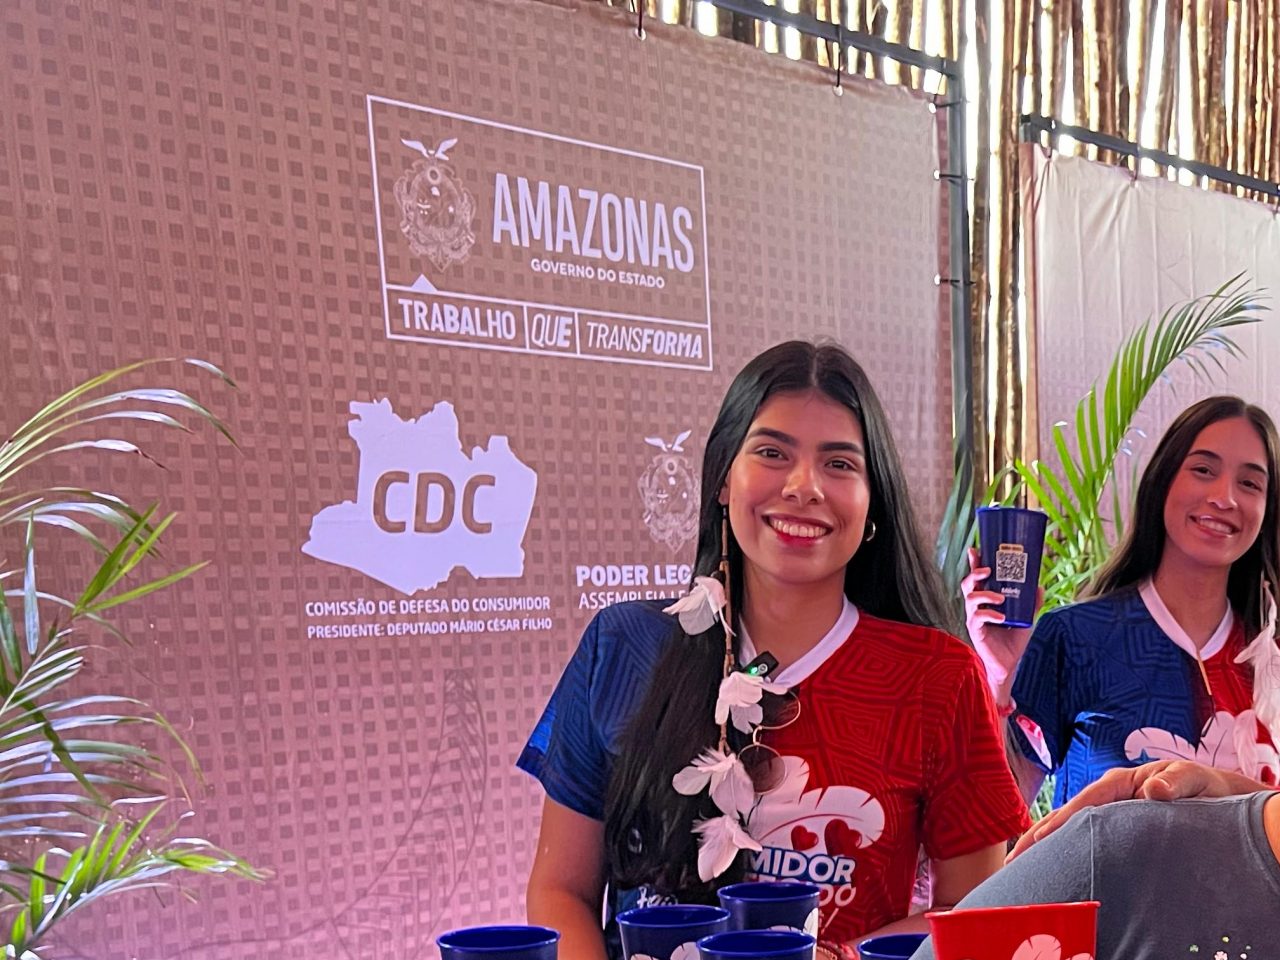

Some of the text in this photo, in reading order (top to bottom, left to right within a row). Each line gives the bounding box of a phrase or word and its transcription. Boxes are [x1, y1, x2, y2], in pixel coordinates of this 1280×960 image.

[493, 172, 694, 273] AMAZONAS
[530, 257, 666, 289] GOVERNO DO ESTADO
[398, 298, 703, 359] TRABALHO QUE TRANSFORMA
[372, 470, 496, 534] CDC
[575, 564, 649, 587] PODER
[305, 596, 551, 617] COMISSÃO DE DEFESA DO CONSUMIDOR
[307, 622, 385, 639] PRESIDENTE:
[387, 621, 448, 637] DEPUTADO
[450, 617, 485, 634] MÁRIO
[487, 615, 520, 632] CÉSAR
